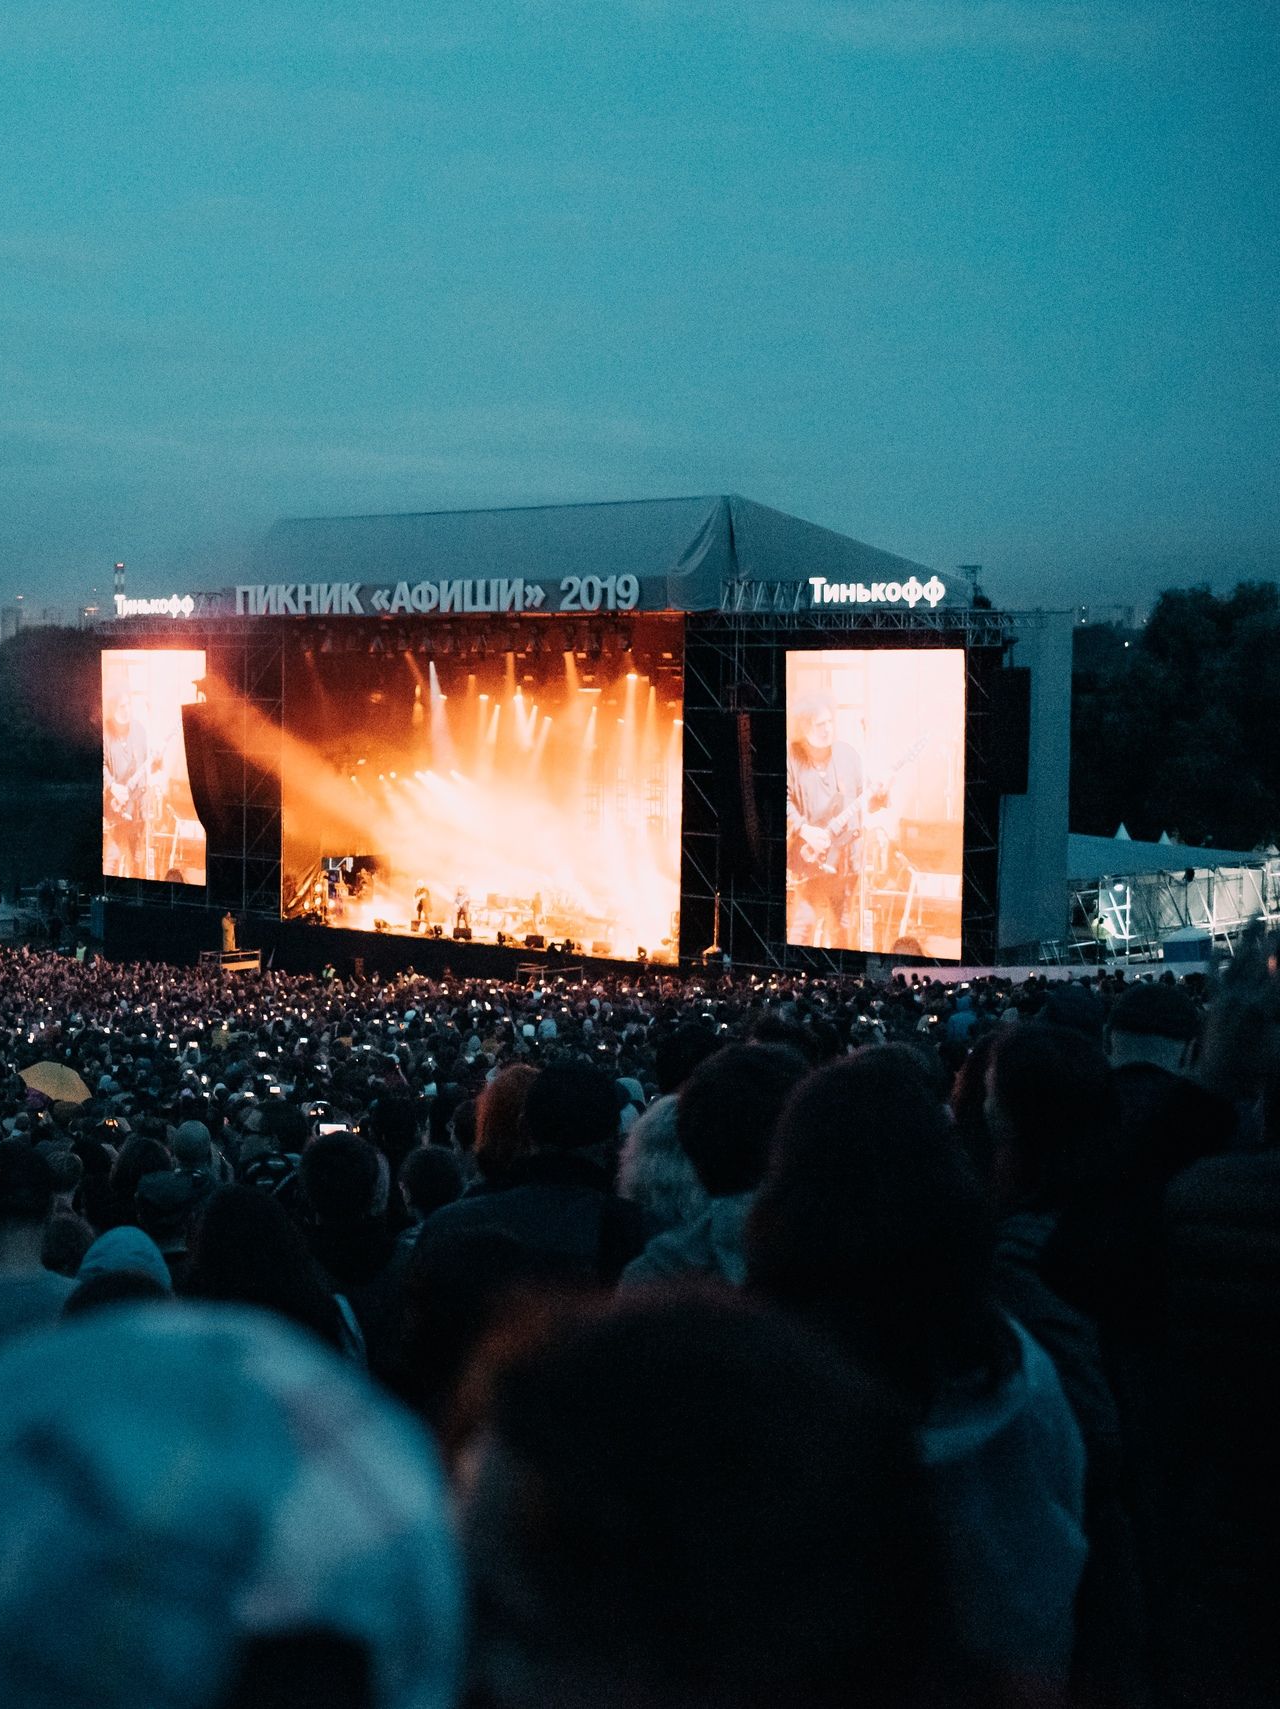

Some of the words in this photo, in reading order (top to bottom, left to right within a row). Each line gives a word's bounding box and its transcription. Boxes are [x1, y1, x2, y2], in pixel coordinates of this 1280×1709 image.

[113, 594, 194, 618] Тинькофф
[236, 583, 365, 615] ПИКНИК
[370, 579, 546, 614] «АФИШИ»
[560, 575, 640, 611] 2019
[809, 576, 945, 608] Тинькофф
